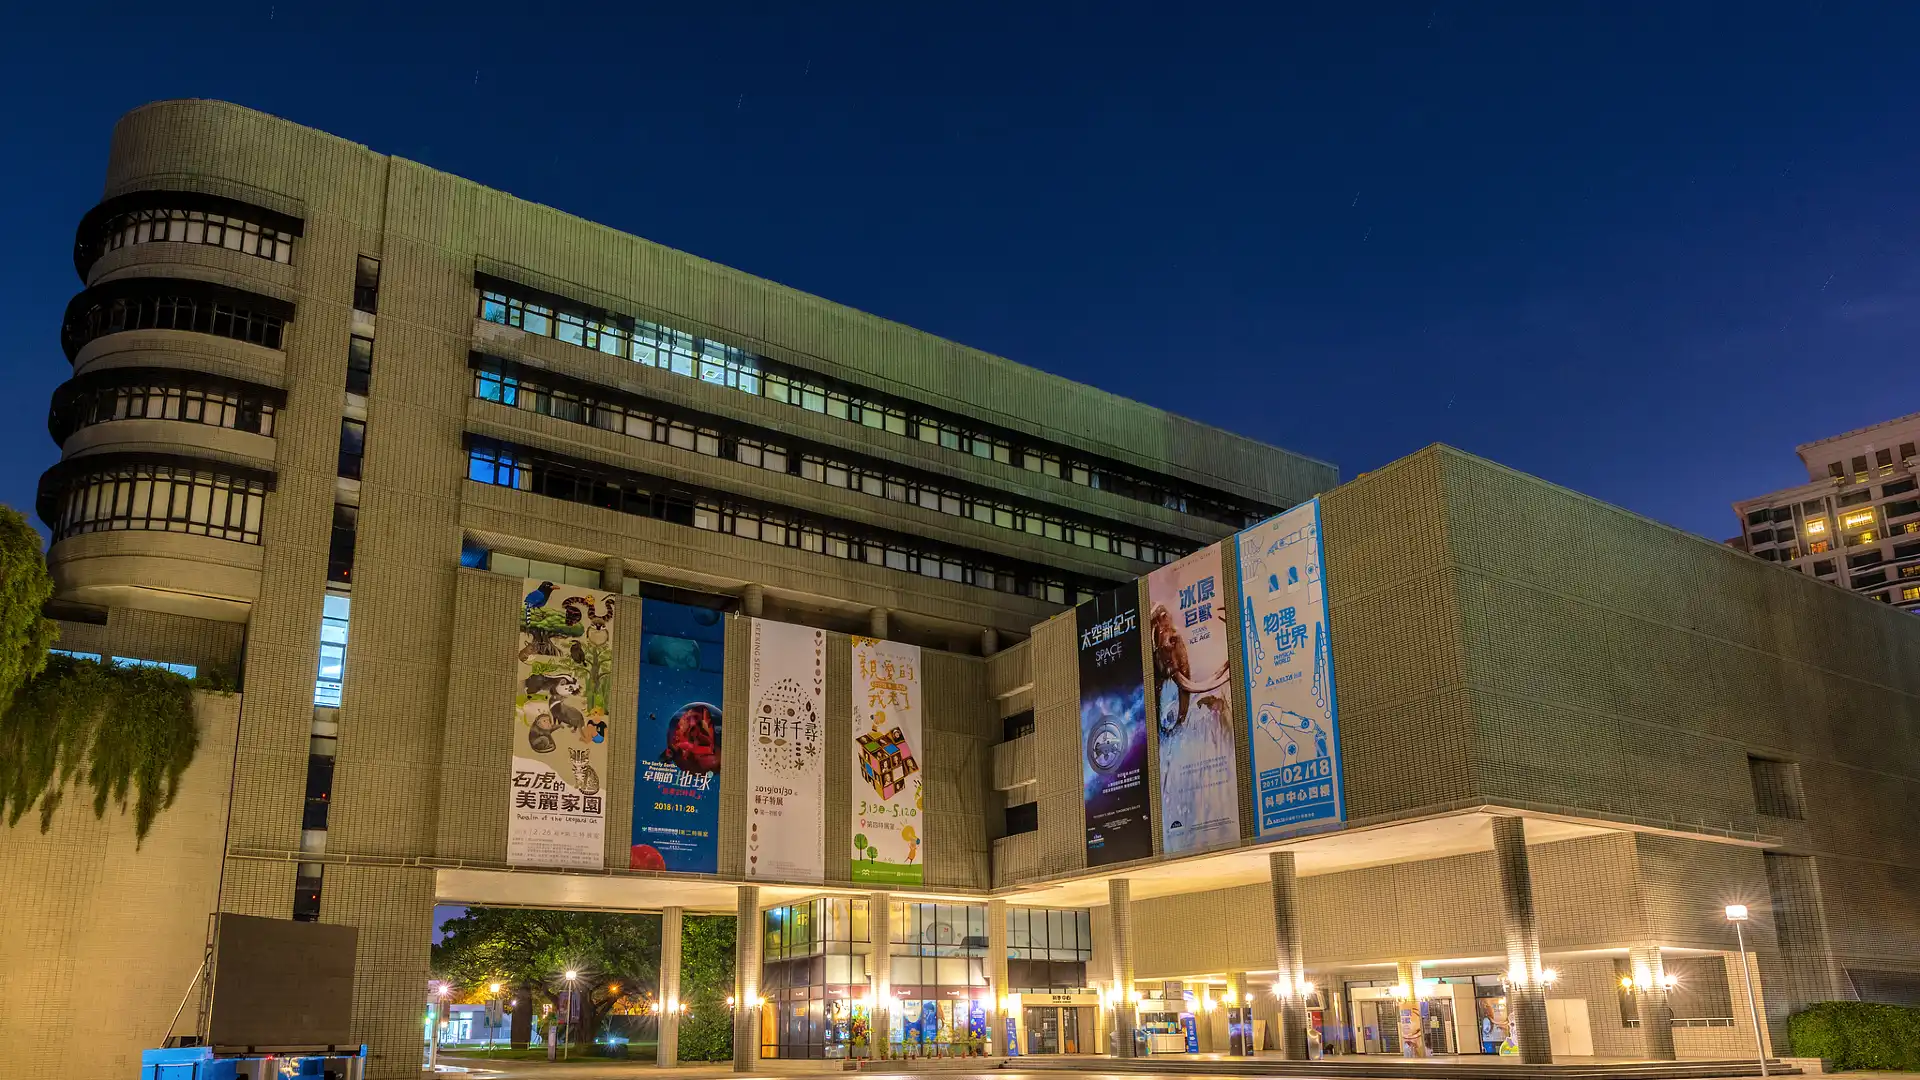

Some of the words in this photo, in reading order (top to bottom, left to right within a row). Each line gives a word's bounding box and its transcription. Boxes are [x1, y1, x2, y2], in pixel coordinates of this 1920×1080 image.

[1179, 576, 1215, 610] 冰原
[1184, 603, 1212, 628] 巨獸
[1263, 606, 1296, 636] 物理
[1081, 608, 1136, 650] 太空新紀元
[1275, 624, 1309, 651] 世界
[1096, 641, 1122, 661] SPACE
[1274, 650, 1295, 661] PHYSICAL
[1274, 657, 1291, 666] WORLD
[868, 691, 911, 711] 我老了
[758, 716, 818, 742] 百籽千尋
[512, 771, 566, 792] 石虎的
[1262, 778, 1279, 789] 2017
[1283, 759, 1330, 784] 02/18
[516, 790, 602, 815] 美麗家園
